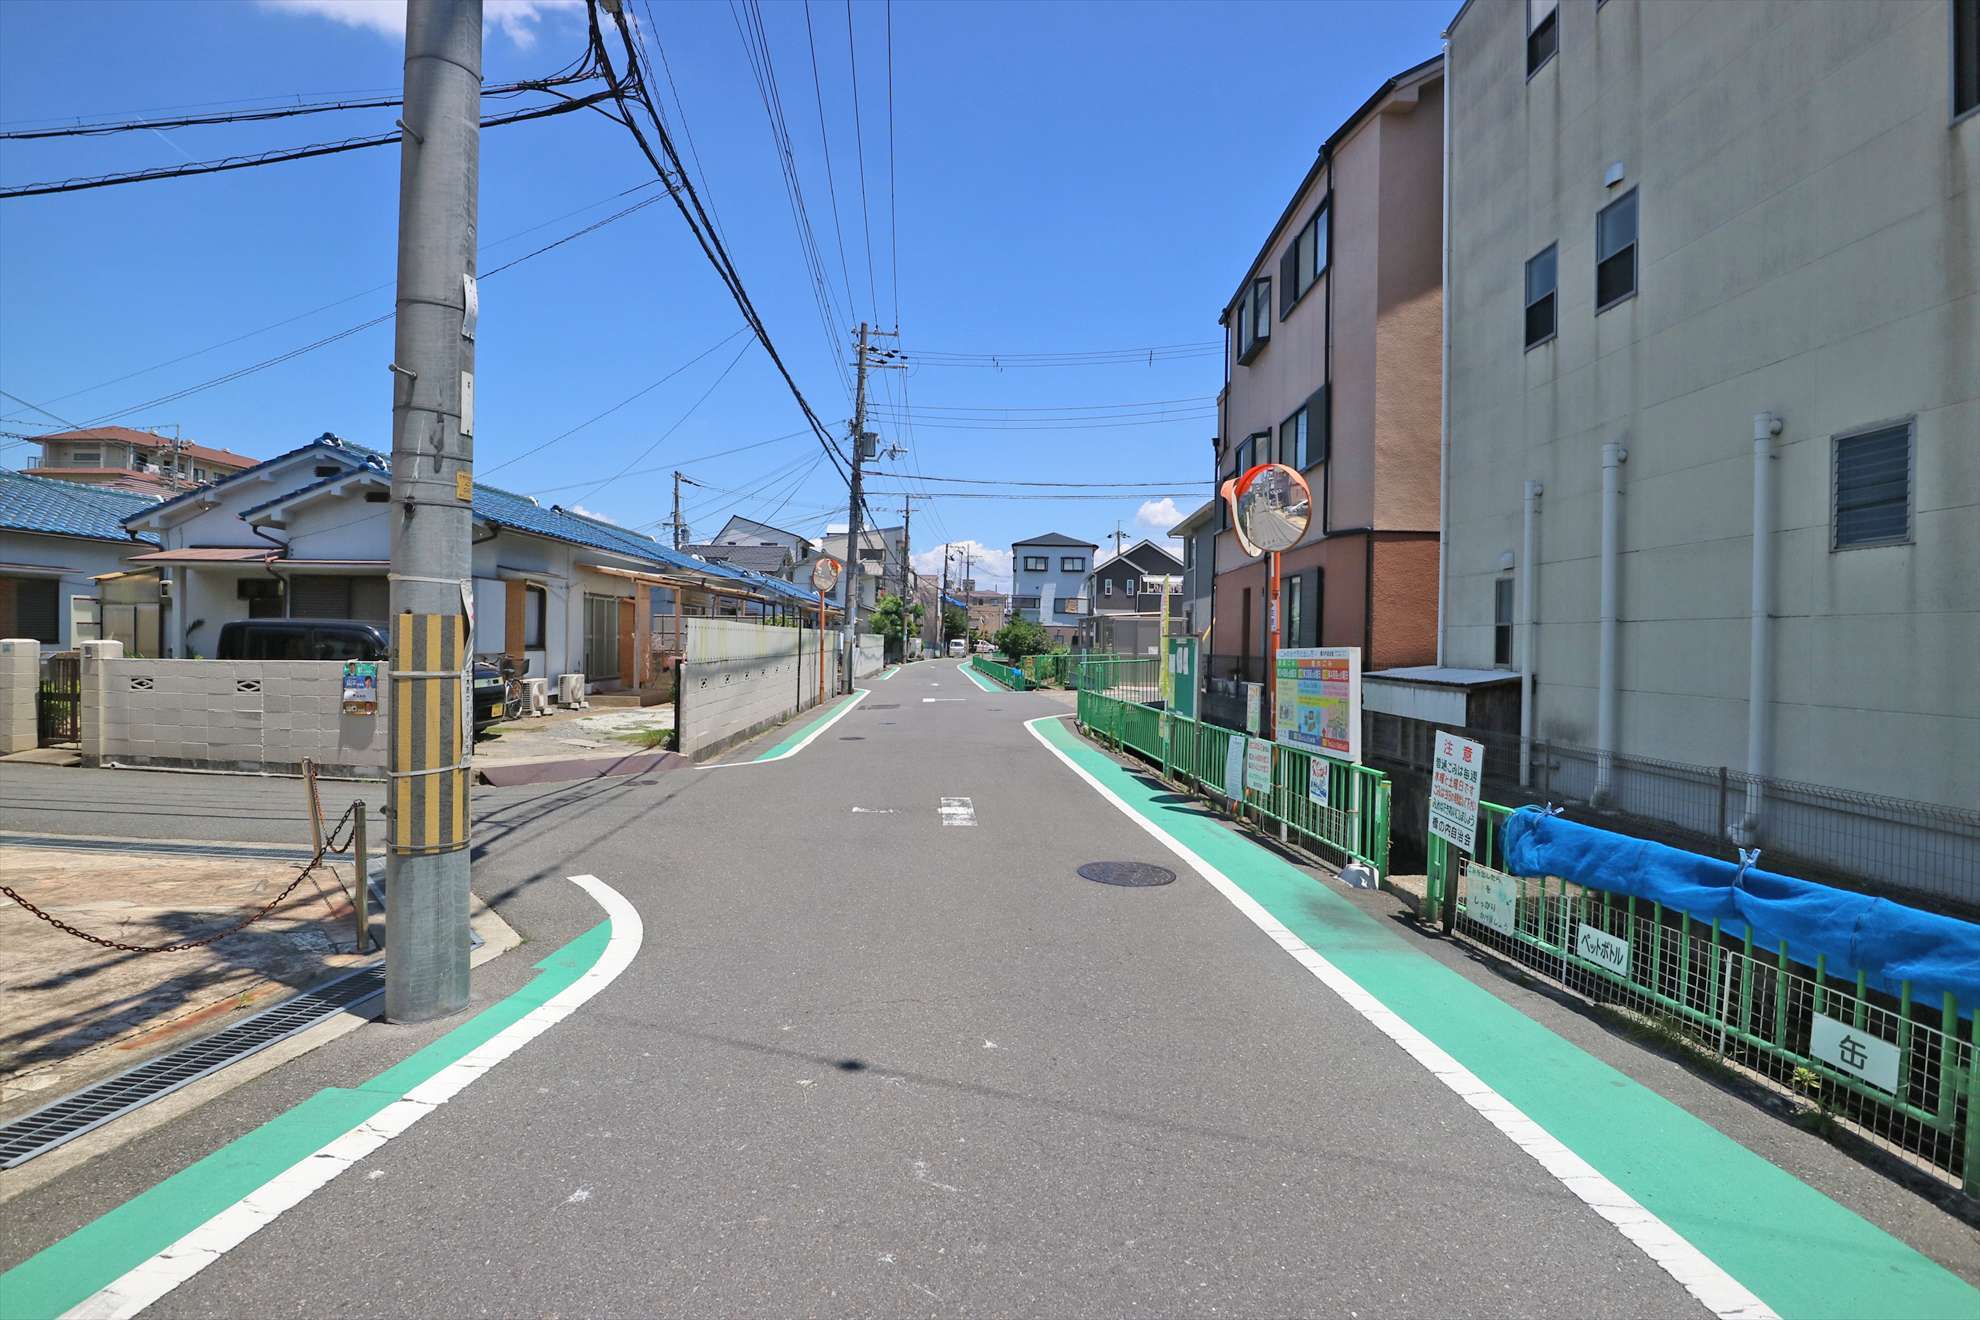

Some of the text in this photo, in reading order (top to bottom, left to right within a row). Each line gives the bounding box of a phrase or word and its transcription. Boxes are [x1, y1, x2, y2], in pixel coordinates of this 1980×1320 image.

[1443, 739, 1473, 763] 注意
[1581, 933, 1624, 966] ペットボトル
[1838, 1034, 1868, 1070] 缶
